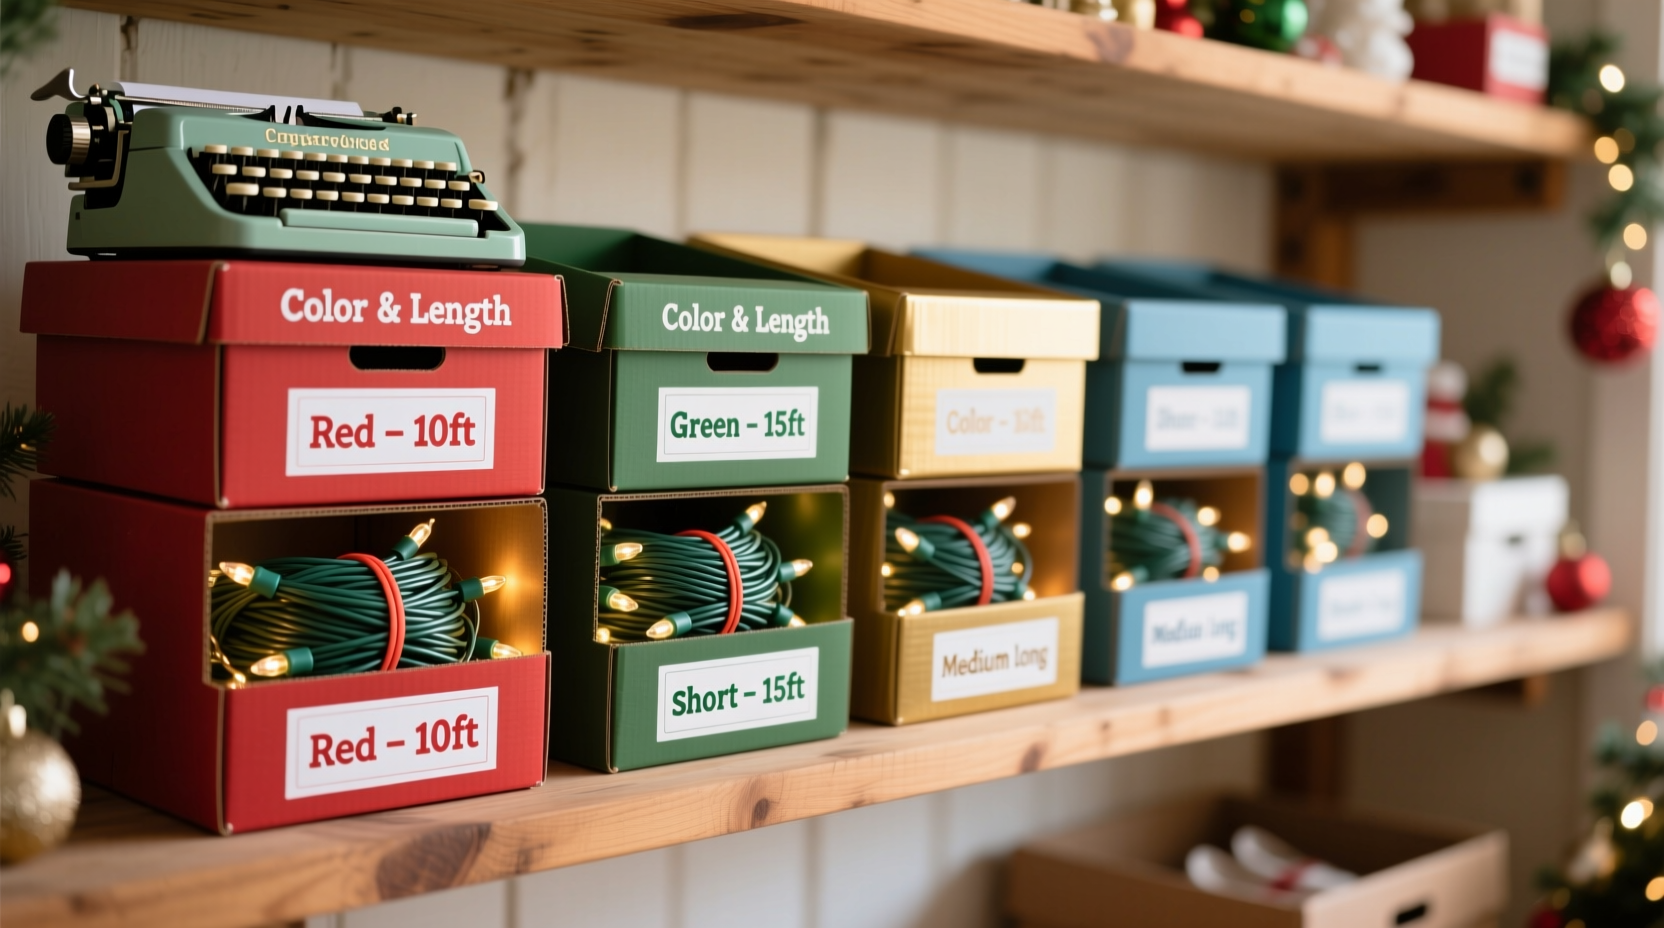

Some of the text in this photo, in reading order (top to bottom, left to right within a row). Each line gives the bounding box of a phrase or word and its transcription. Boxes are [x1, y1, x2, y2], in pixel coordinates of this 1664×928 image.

[280, 287, 513, 335] Color & Length
[661, 302, 831, 344] Color & Length
[309, 413, 376, 449] Red
[413, 411, 476, 447] 10ft
[670, 410, 740, 439] Green
[764, 408, 806, 438] 15ft
[946, 408, 994, 435] Color
[942, 644, 1048, 678] Medium long
[672, 683, 739, 717] Short
[762, 671, 806, 704] 15ft
[308, 725, 377, 769] Red
[415, 713, 479, 756] 10ft
